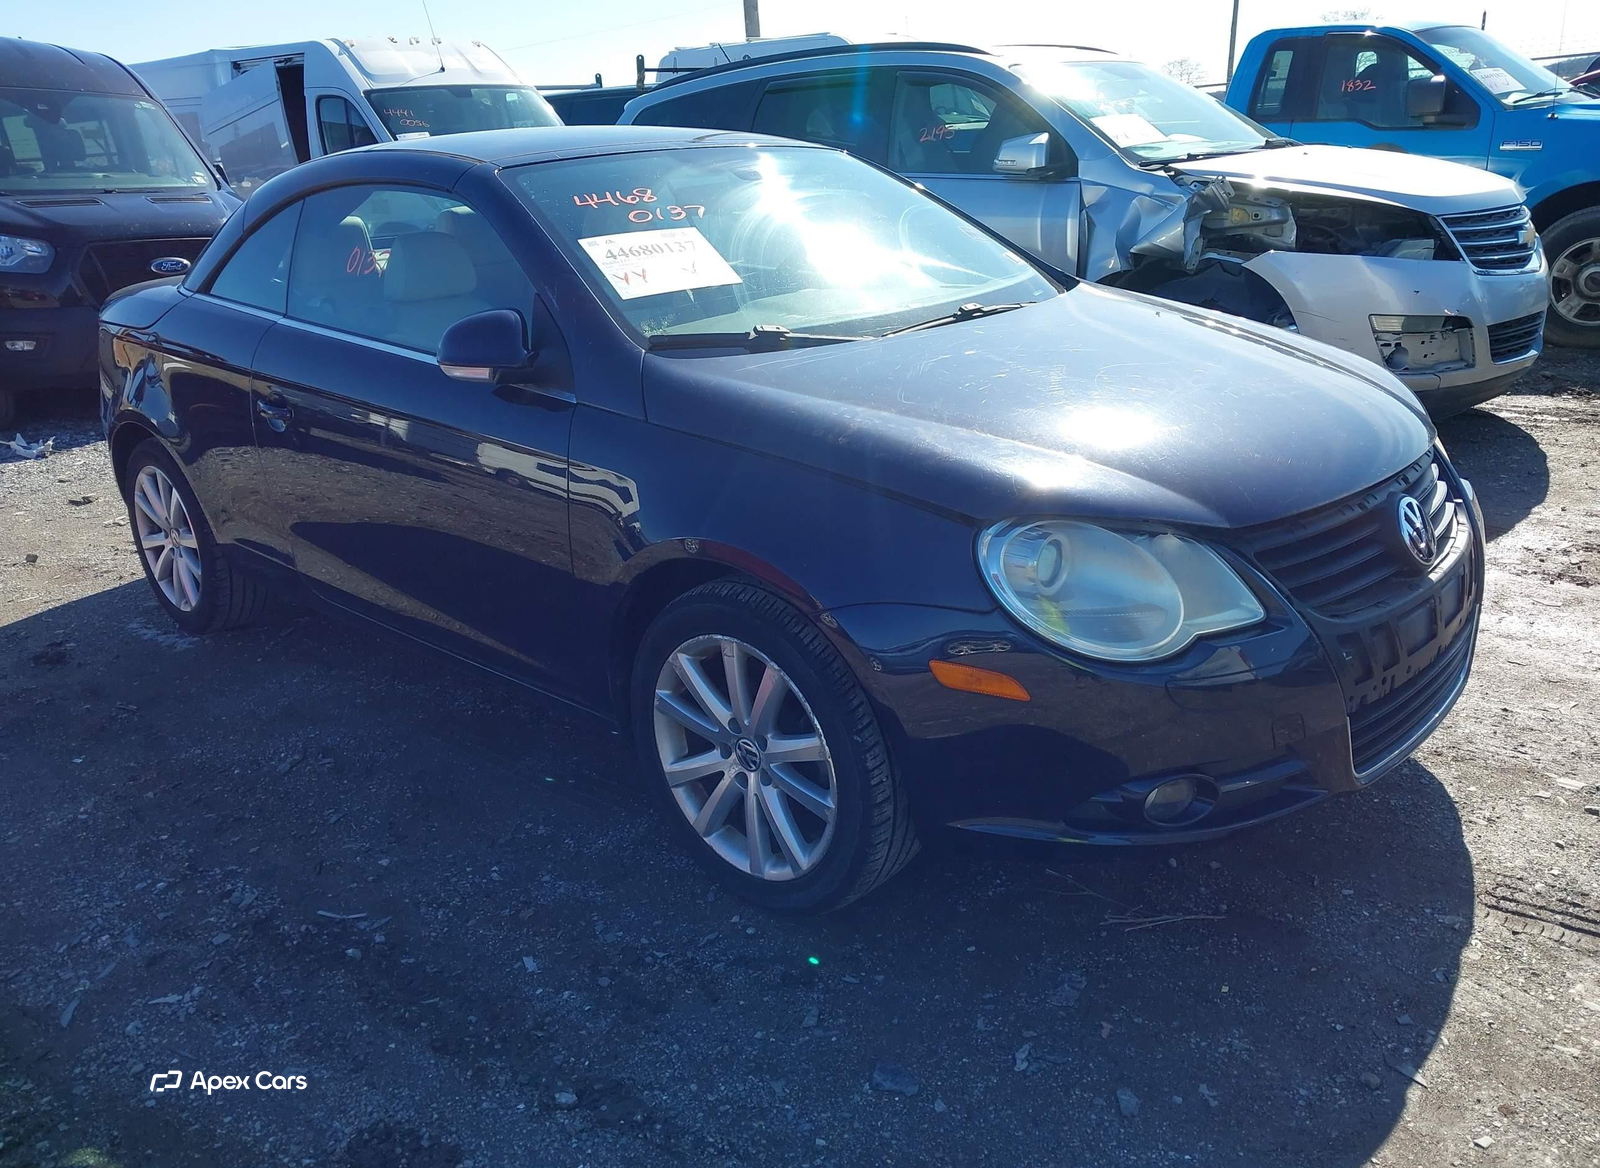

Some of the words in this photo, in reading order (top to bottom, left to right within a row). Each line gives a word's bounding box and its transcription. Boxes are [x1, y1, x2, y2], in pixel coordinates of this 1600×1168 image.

[1341, 79, 1377, 92] 1832
[384, 108, 414, 117] 4441
[919, 126, 955, 142] 2195
[573, 187, 657, 209] 4468
[628, 205, 706, 223] 0137
[605, 240, 696, 260] 44680137
